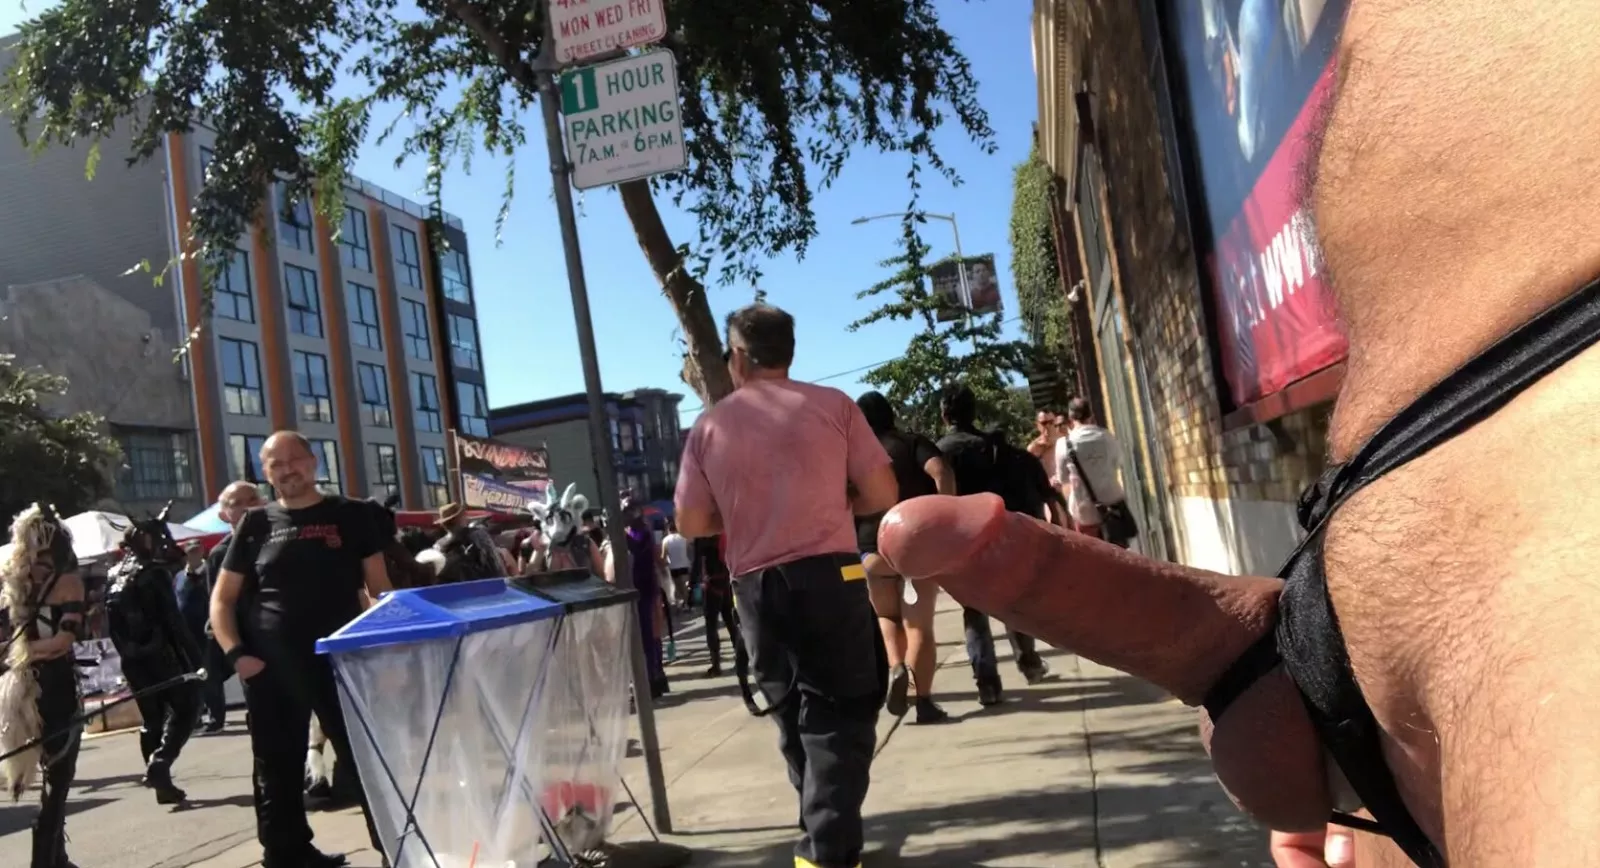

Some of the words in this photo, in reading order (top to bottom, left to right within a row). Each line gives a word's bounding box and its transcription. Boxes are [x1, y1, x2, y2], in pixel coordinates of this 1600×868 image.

[560, 14, 591, 38] MON
[594, 4, 624, 28] WED
[628, 0, 652, 18] FRI
[563, 38, 602, 60] STREET
[604, 23, 656, 49] CLEANING
[572, 73, 586, 110] 1
[606, 63, 665, 96] HOUR
[571, 100, 674, 142] PARKING
